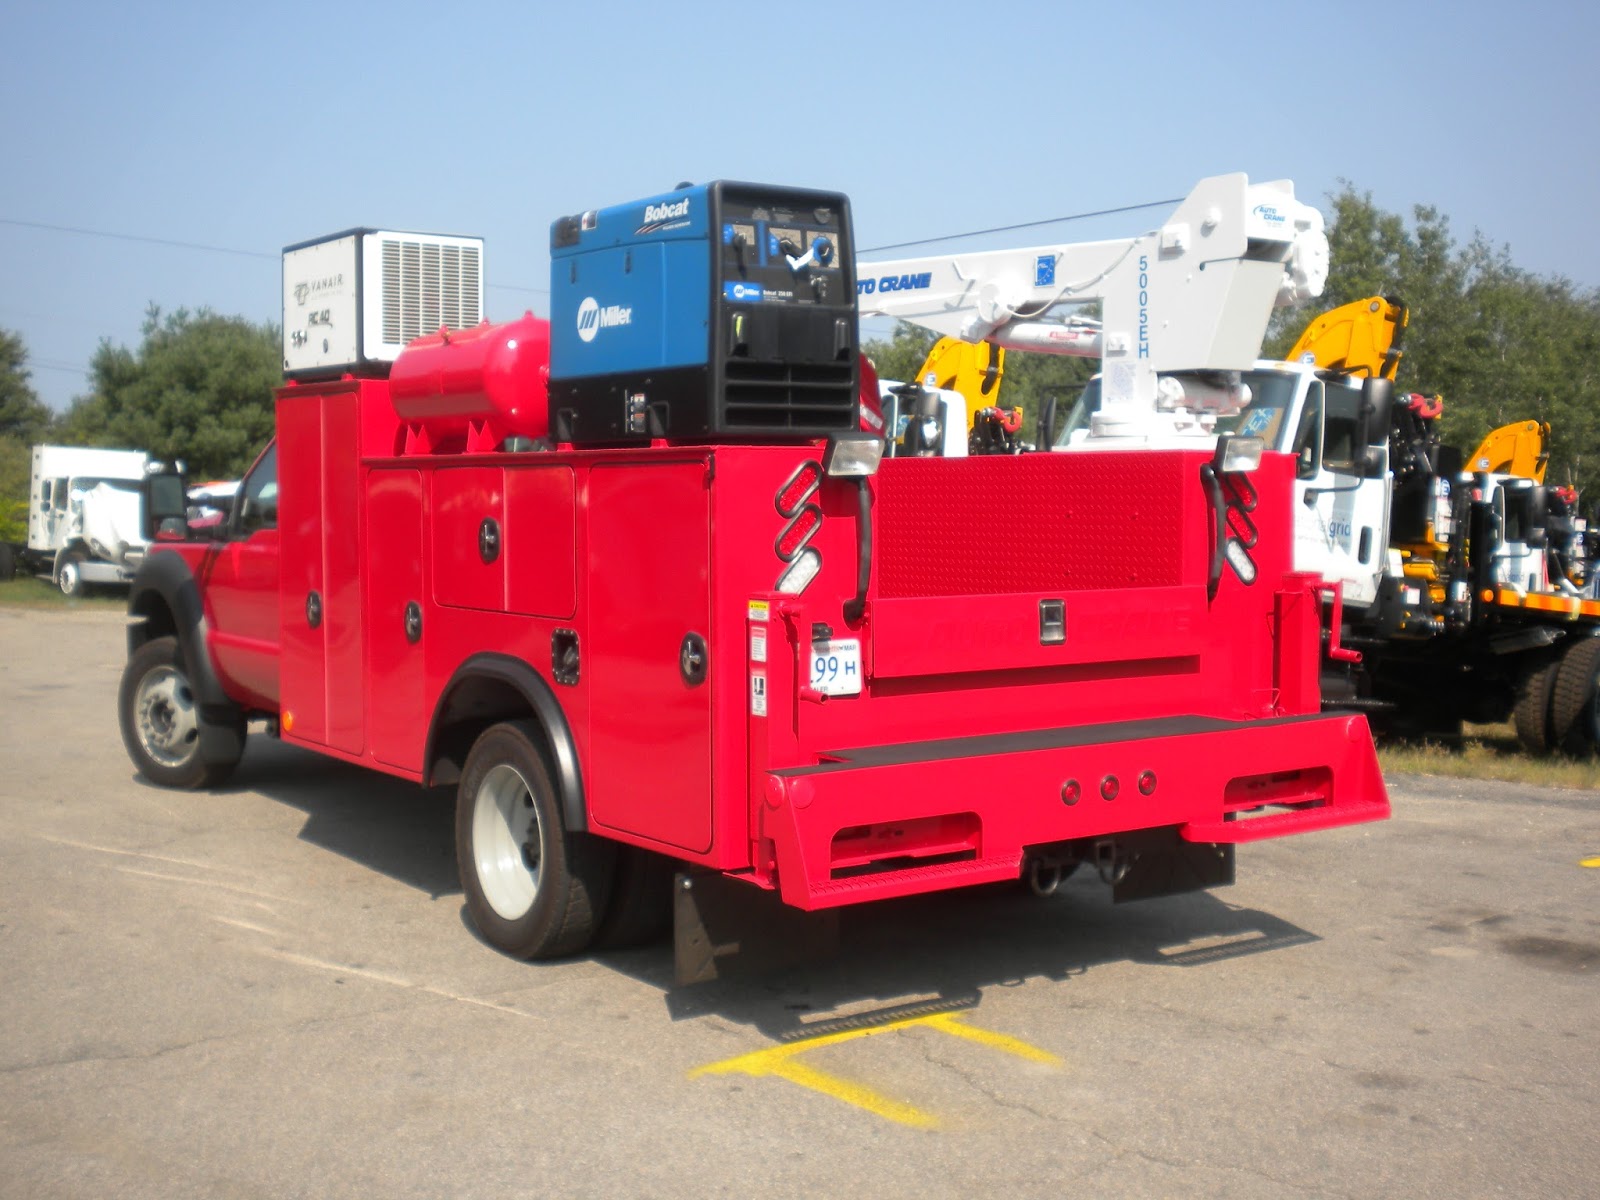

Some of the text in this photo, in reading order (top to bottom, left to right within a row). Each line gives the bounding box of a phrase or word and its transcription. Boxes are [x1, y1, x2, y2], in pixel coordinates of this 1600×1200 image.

[644, 198, 690, 223] Bobcat
[311, 273, 343, 291] VANAIR
[856, 272, 932, 295] TO CRANE
[600, 305, 632, 328] Miller
[844, 660, 856, 675] H
